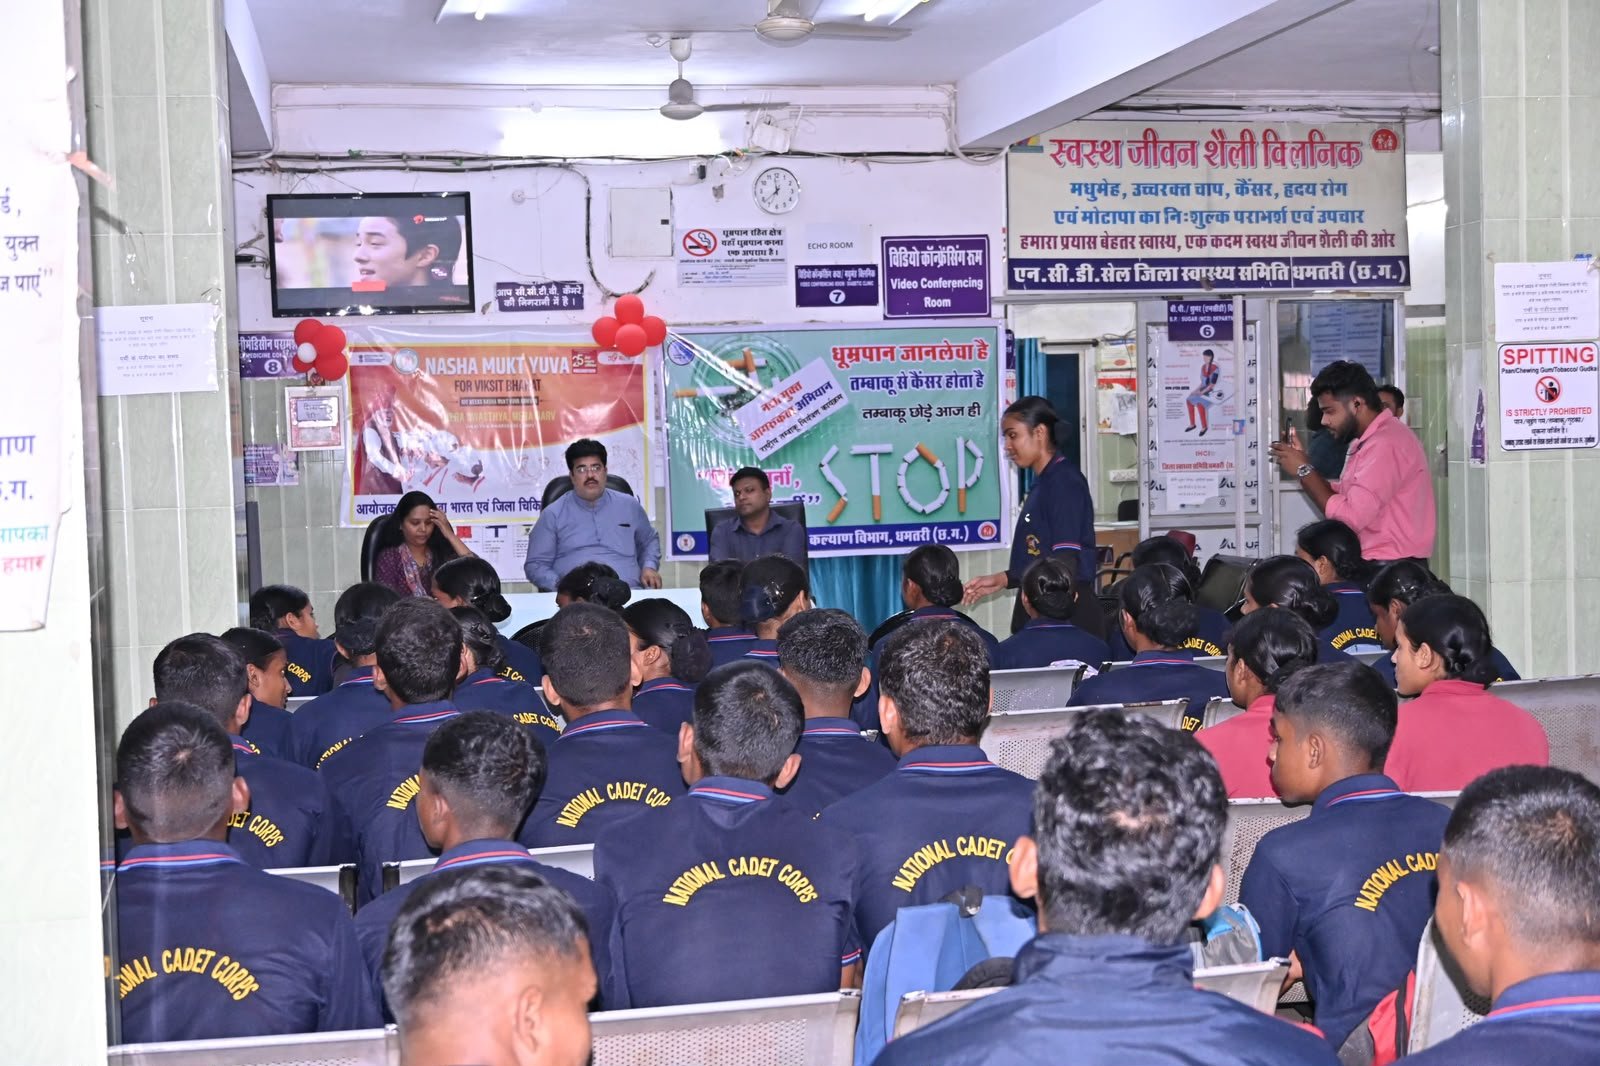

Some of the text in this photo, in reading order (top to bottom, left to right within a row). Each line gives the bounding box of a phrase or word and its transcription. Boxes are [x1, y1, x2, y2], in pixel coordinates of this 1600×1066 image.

[1049, 139, 1122, 168] स्वस्थ
[1127, 128, 1198, 168] जीवन
[1203, 128, 1257, 168] शैली
[1132, 182, 1191, 197] उच्चरक्त
[1320, 179, 1348, 196] रोग
[1054, 206, 1079, 225] एवं
[1081, 206, 1136, 225] मोटापा
[1138, 210, 1161, 225] का
[1291, 206, 1315, 224] एवं
[1317, 210, 1365, 224] उपचार
[808, 241, 854, 250] ECHO ROOM
[1020, 235, 1058, 250] हमारा
[1060, 235, 1097, 251] प्रयास
[1100, 231, 1136, 250] बेहतर
[1185, 235, 1207, 250] एक
[1210, 234, 1243, 249] कदम
[1245, 234, 1278, 249] स्वस्थ
[1280, 230, 1316, 249] जीवन
[1319, 229, 1349, 248] शैली
[1350, 230, 1368, 248] की
[1370, 229, 1395, 248] ओर
[1133, 263, 1179, 282] जिला
[1238, 262, 1290, 281] समिति
[1292, 261, 1345, 281] धमतरी
[890, 277, 984, 290] Video Conferencing
[832, 291, 842, 302] 7
[923, 297, 952, 308] Room
[1203, 327, 1212, 337] 6
[832, 346, 897, 369] धूम्रपान
[900, 341, 973, 361] जानलेवा
[974, 339, 989, 360] है
[1503, 346, 1595, 365] SPITTING
[268, 361, 279, 372] 8
[425, 356, 479, 375] NASHA
[481, 355, 525, 375] MUKT
[527, 355, 570, 375] YUVA
[454, 380, 472, 392] FOR
[474, 379, 505, 392] VIKSIT
[850, 369, 984, 395] तम्बाकू से कैंसर होता है
[862, 407, 907, 423] तम्बाकू
[935, 406, 964, 418] आज
[967, 402, 981, 416] ही
[1506, 406, 1592, 417] IS STRICTLY PROHIBITED
[450, 501, 473, 514] भारत
[476, 499, 489, 515] एवं
[492, 497, 516, 513] जिला
[809, 533, 853, 546] कल्याण
[895, 528, 931, 542] धमतरी
[1356, 627, 1377, 640] CADE
[1204, 642, 1222, 656] CORP
[287, 662, 312, 683] CORPS
[1181, 715, 1200, 731] DET
[556, 787, 605, 828] NATIONAL
[606, 781, 648, 801] CADET
[248, 815, 284, 847] CORPS
[892, 839, 957, 893] NATIONAL
[956, 835, 1006, 860] CADET
[662, 856, 819, 907] NATIONAL CADET CORPS
[1354, 852, 1440, 912] NATIONAL CAD
[161, 947, 217, 975] CADET
[211, 955, 260, 1001] CORPS
